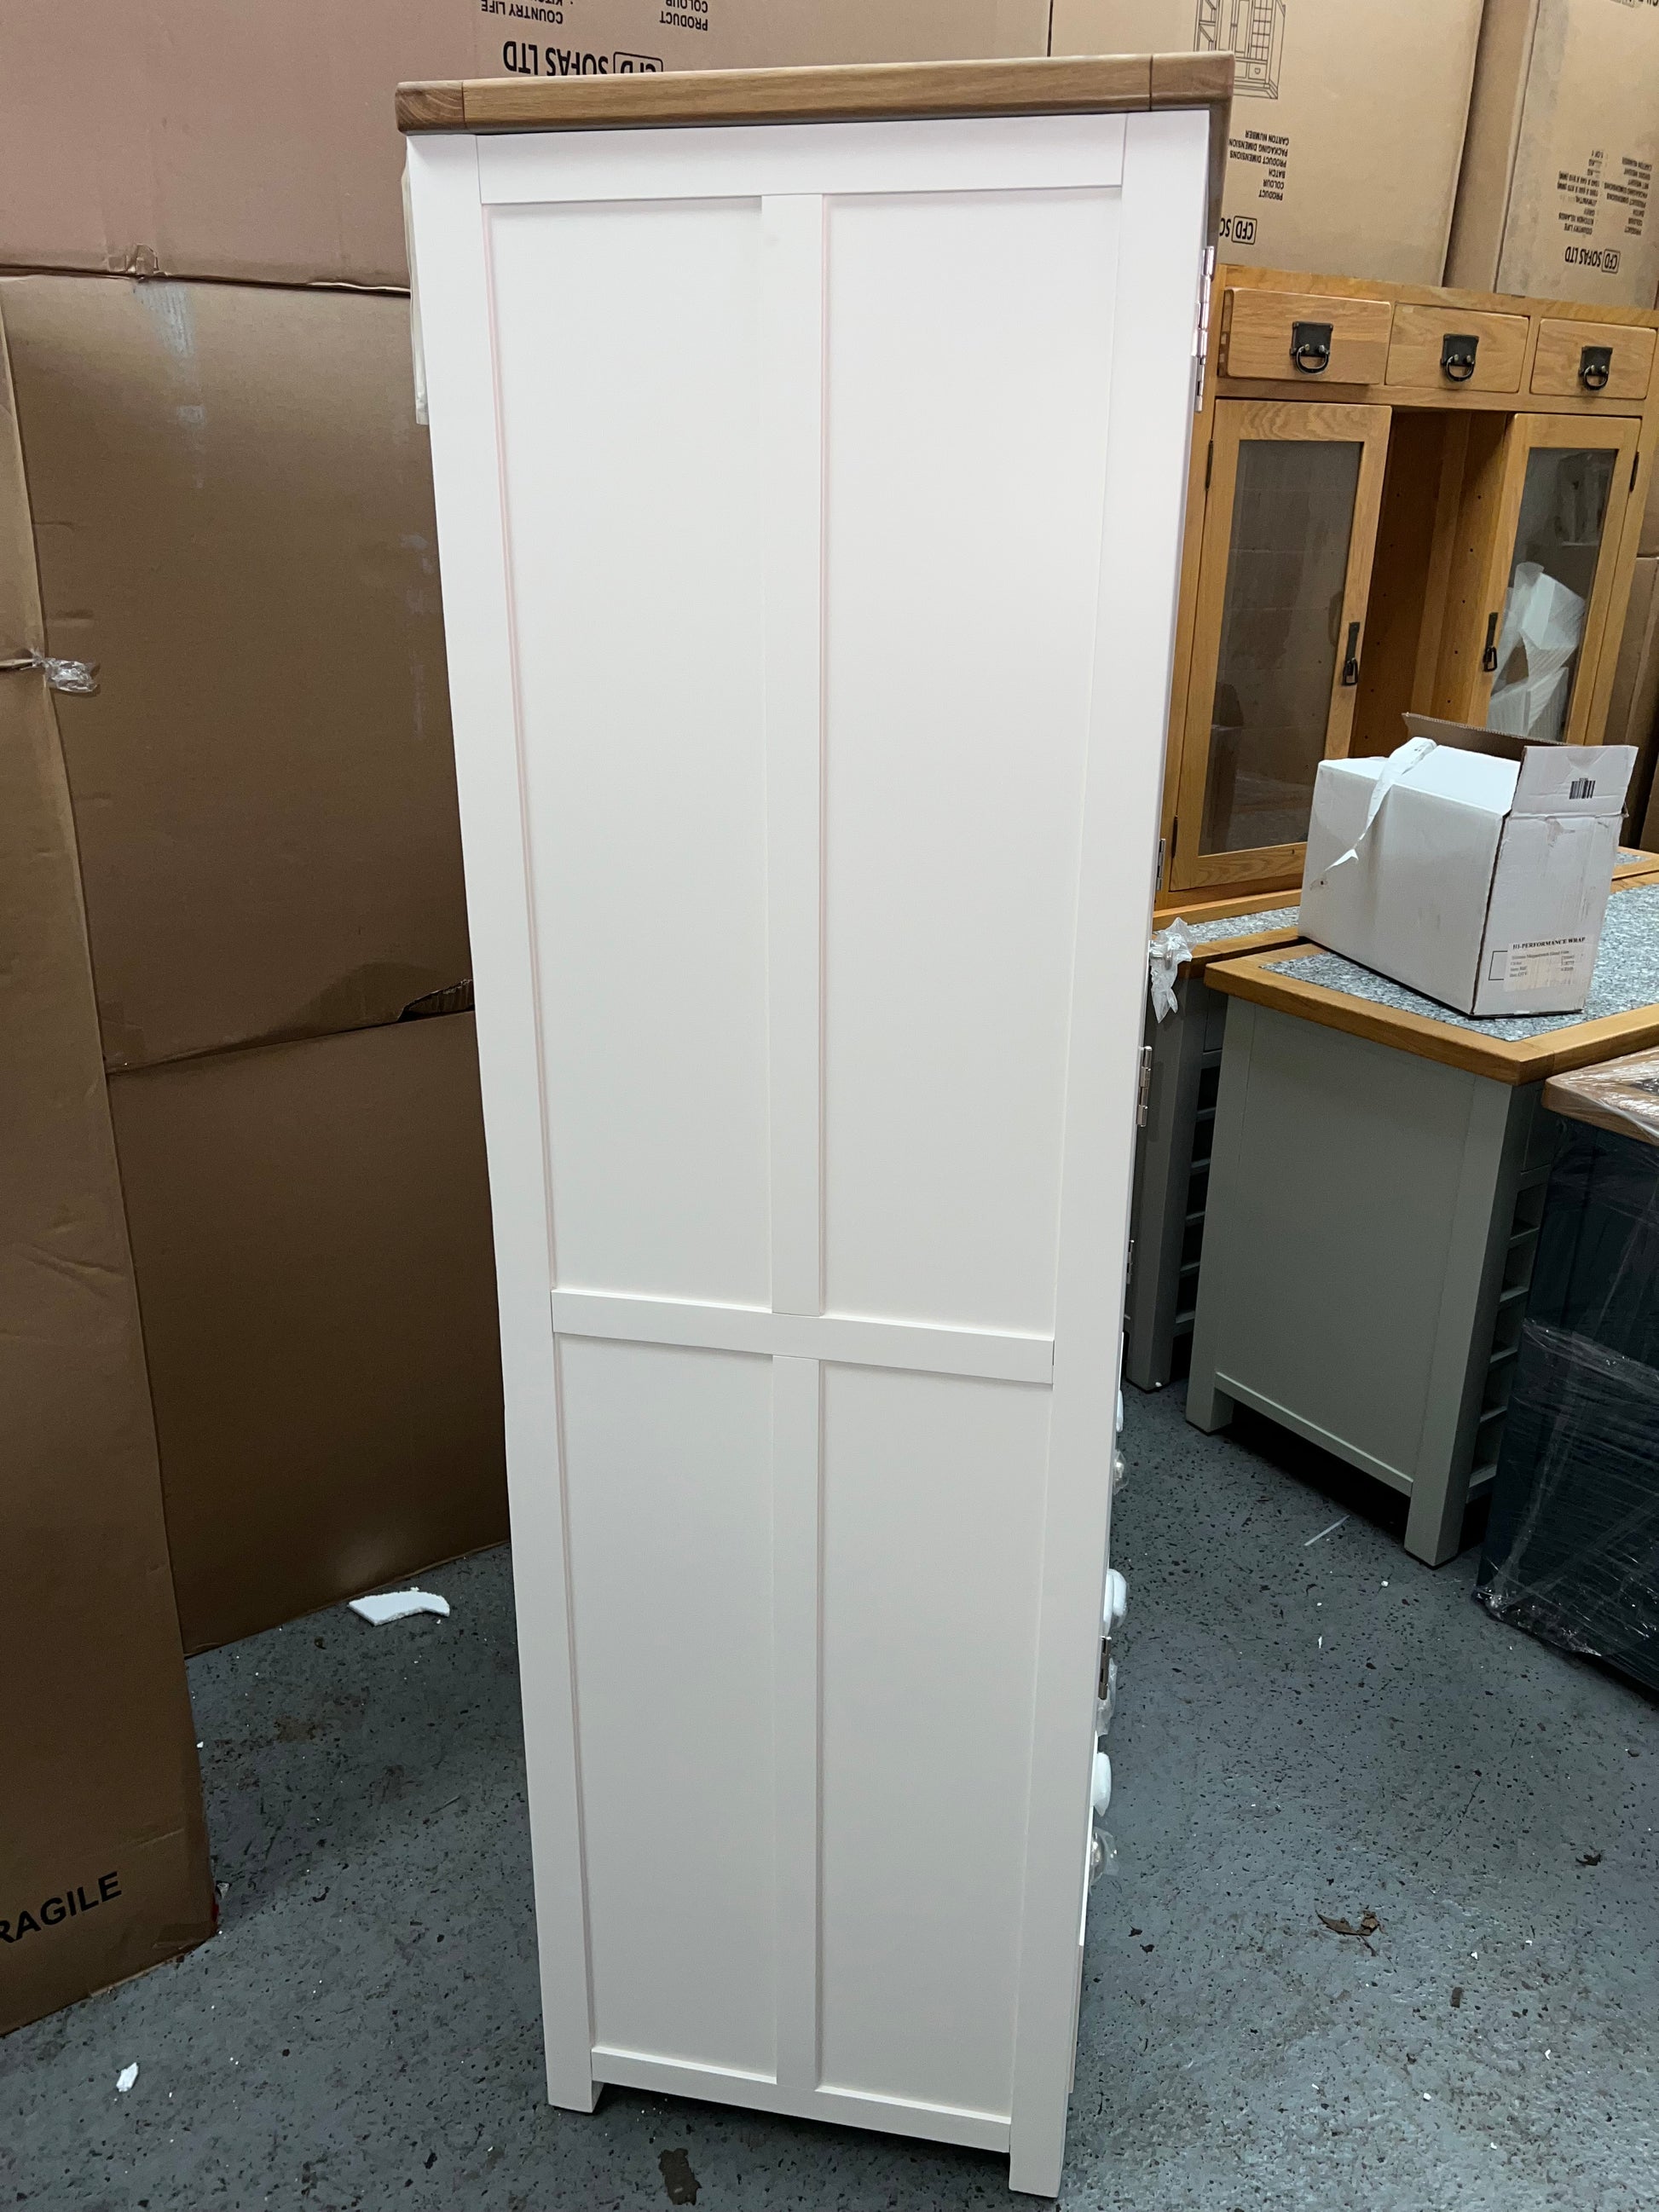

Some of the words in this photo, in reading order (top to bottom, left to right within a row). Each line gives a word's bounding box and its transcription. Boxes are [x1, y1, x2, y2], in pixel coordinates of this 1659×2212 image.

[482, 0, 506, 14] LIFE
[509, 3, 564, 25] COUNTRY
[659, 10, 708, 31] PRODUCT
[503, 40, 538, 76] LTD
[1268, 135, 1290, 147] CARTON
[1229, 150, 1262, 164] DIMENSIONS
[1258, 143, 1288, 158] PACKAGING
[1263, 156, 1287, 168] PRODUCT
[1269, 169, 1286, 179] BATCH
[1263, 179, 1285, 190] COLOUR
[1258, 189, 1283, 201] PRODUCT
[1235, 220, 1254, 240] CFD
[1564, 246, 1579, 264] LTD
[1579, 249, 1603, 268] SOFAS
[1604, 253, 1618, 269] CFD
